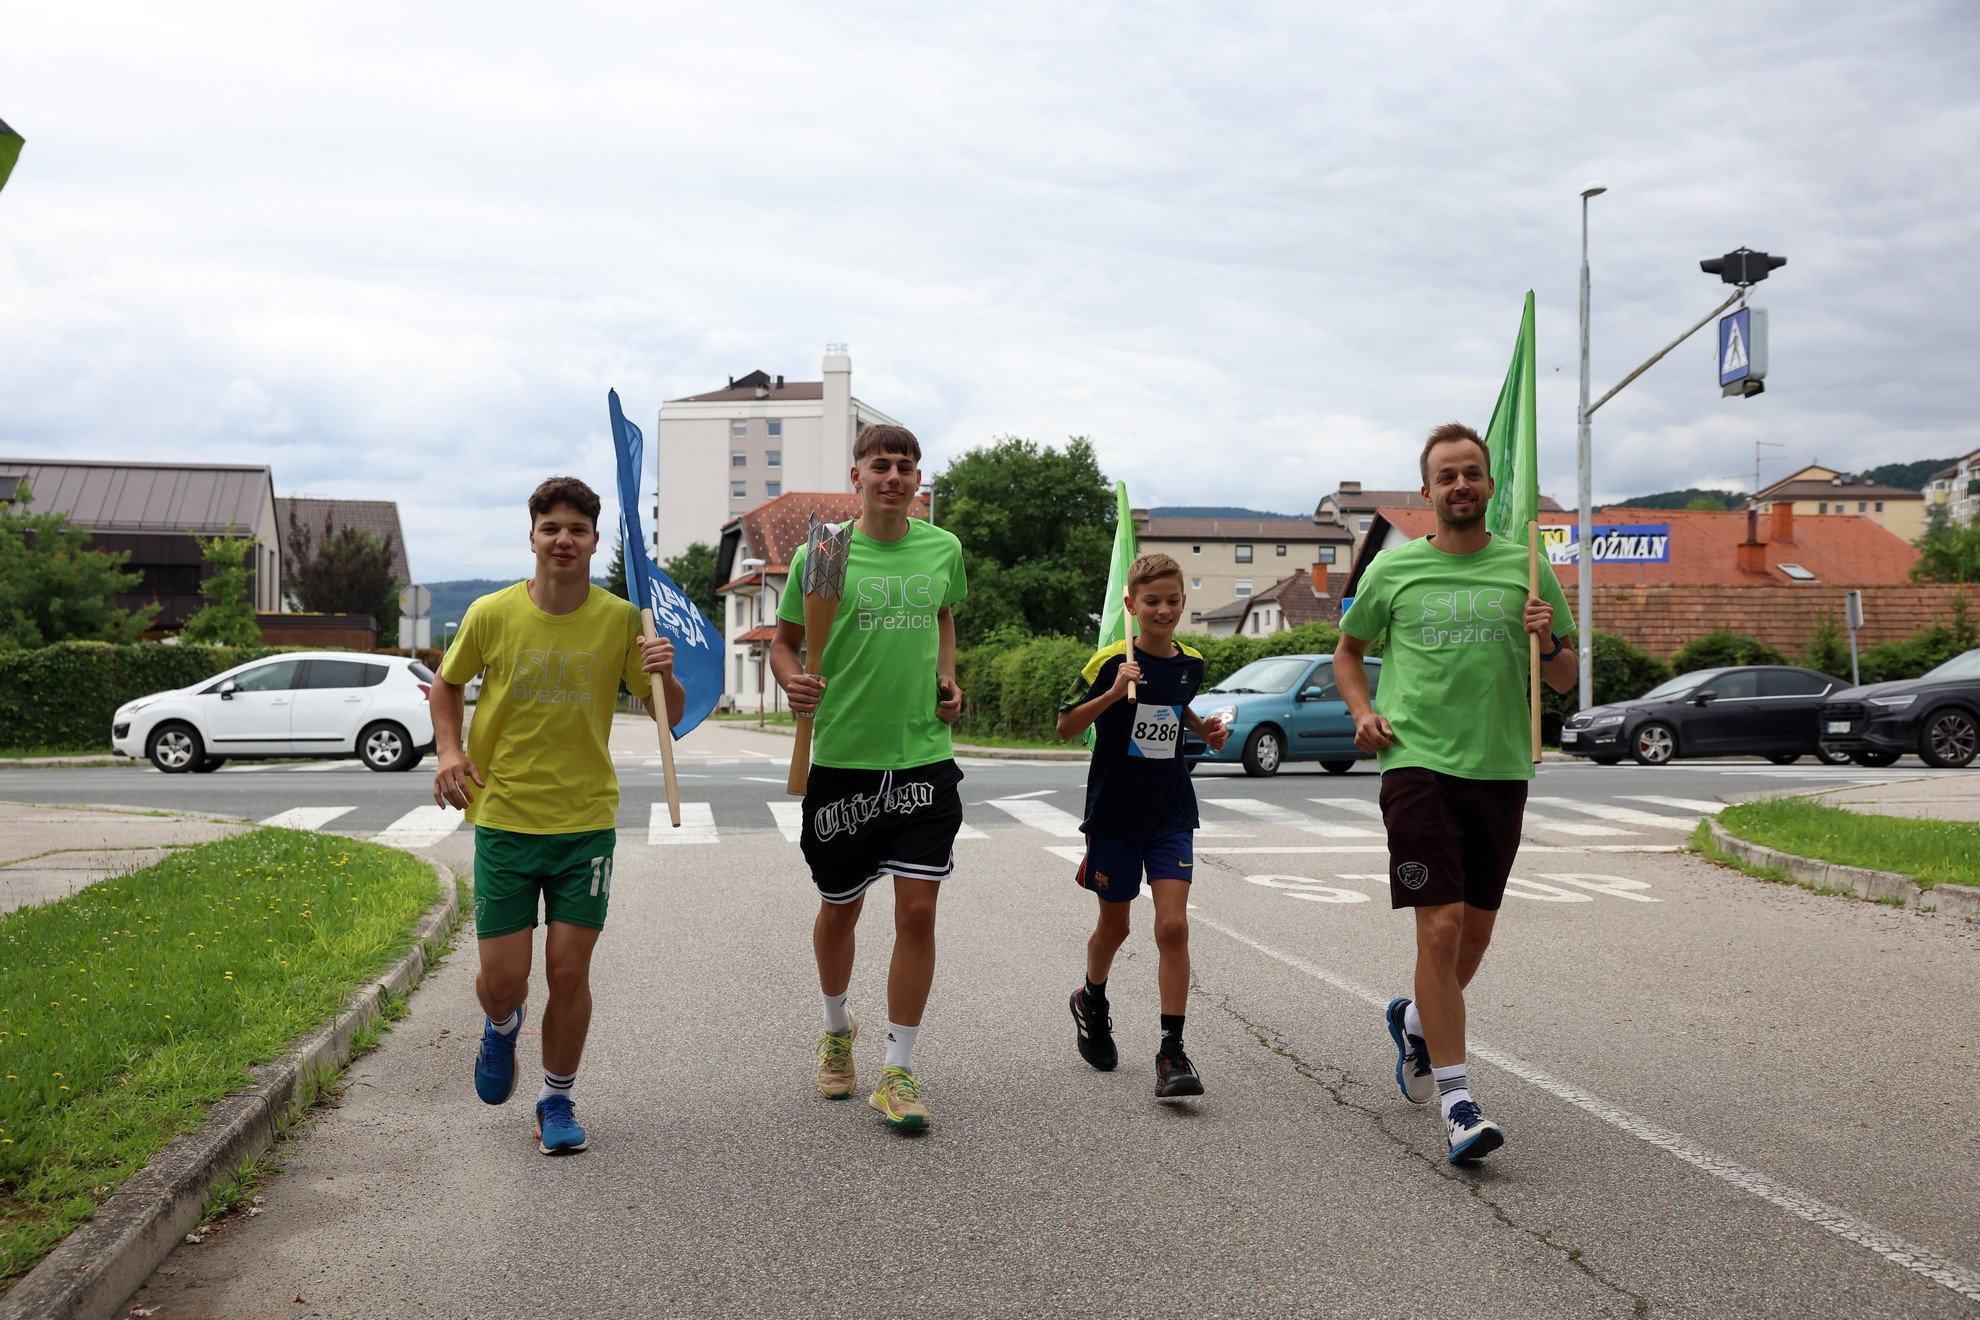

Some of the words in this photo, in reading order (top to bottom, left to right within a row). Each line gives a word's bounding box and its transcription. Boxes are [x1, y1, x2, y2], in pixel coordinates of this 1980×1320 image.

[1576, 529, 1668, 560] OŽMAN
[857, 574, 933, 610] SIC
[1421, 588, 1506, 624] SIC
[858, 610, 932, 630] Brežice
[1422, 624, 1505, 645] Brežice
[514, 648, 595, 686] SIC
[513, 683, 592, 705] Brežice
[1135, 722, 1177, 741] 8286
